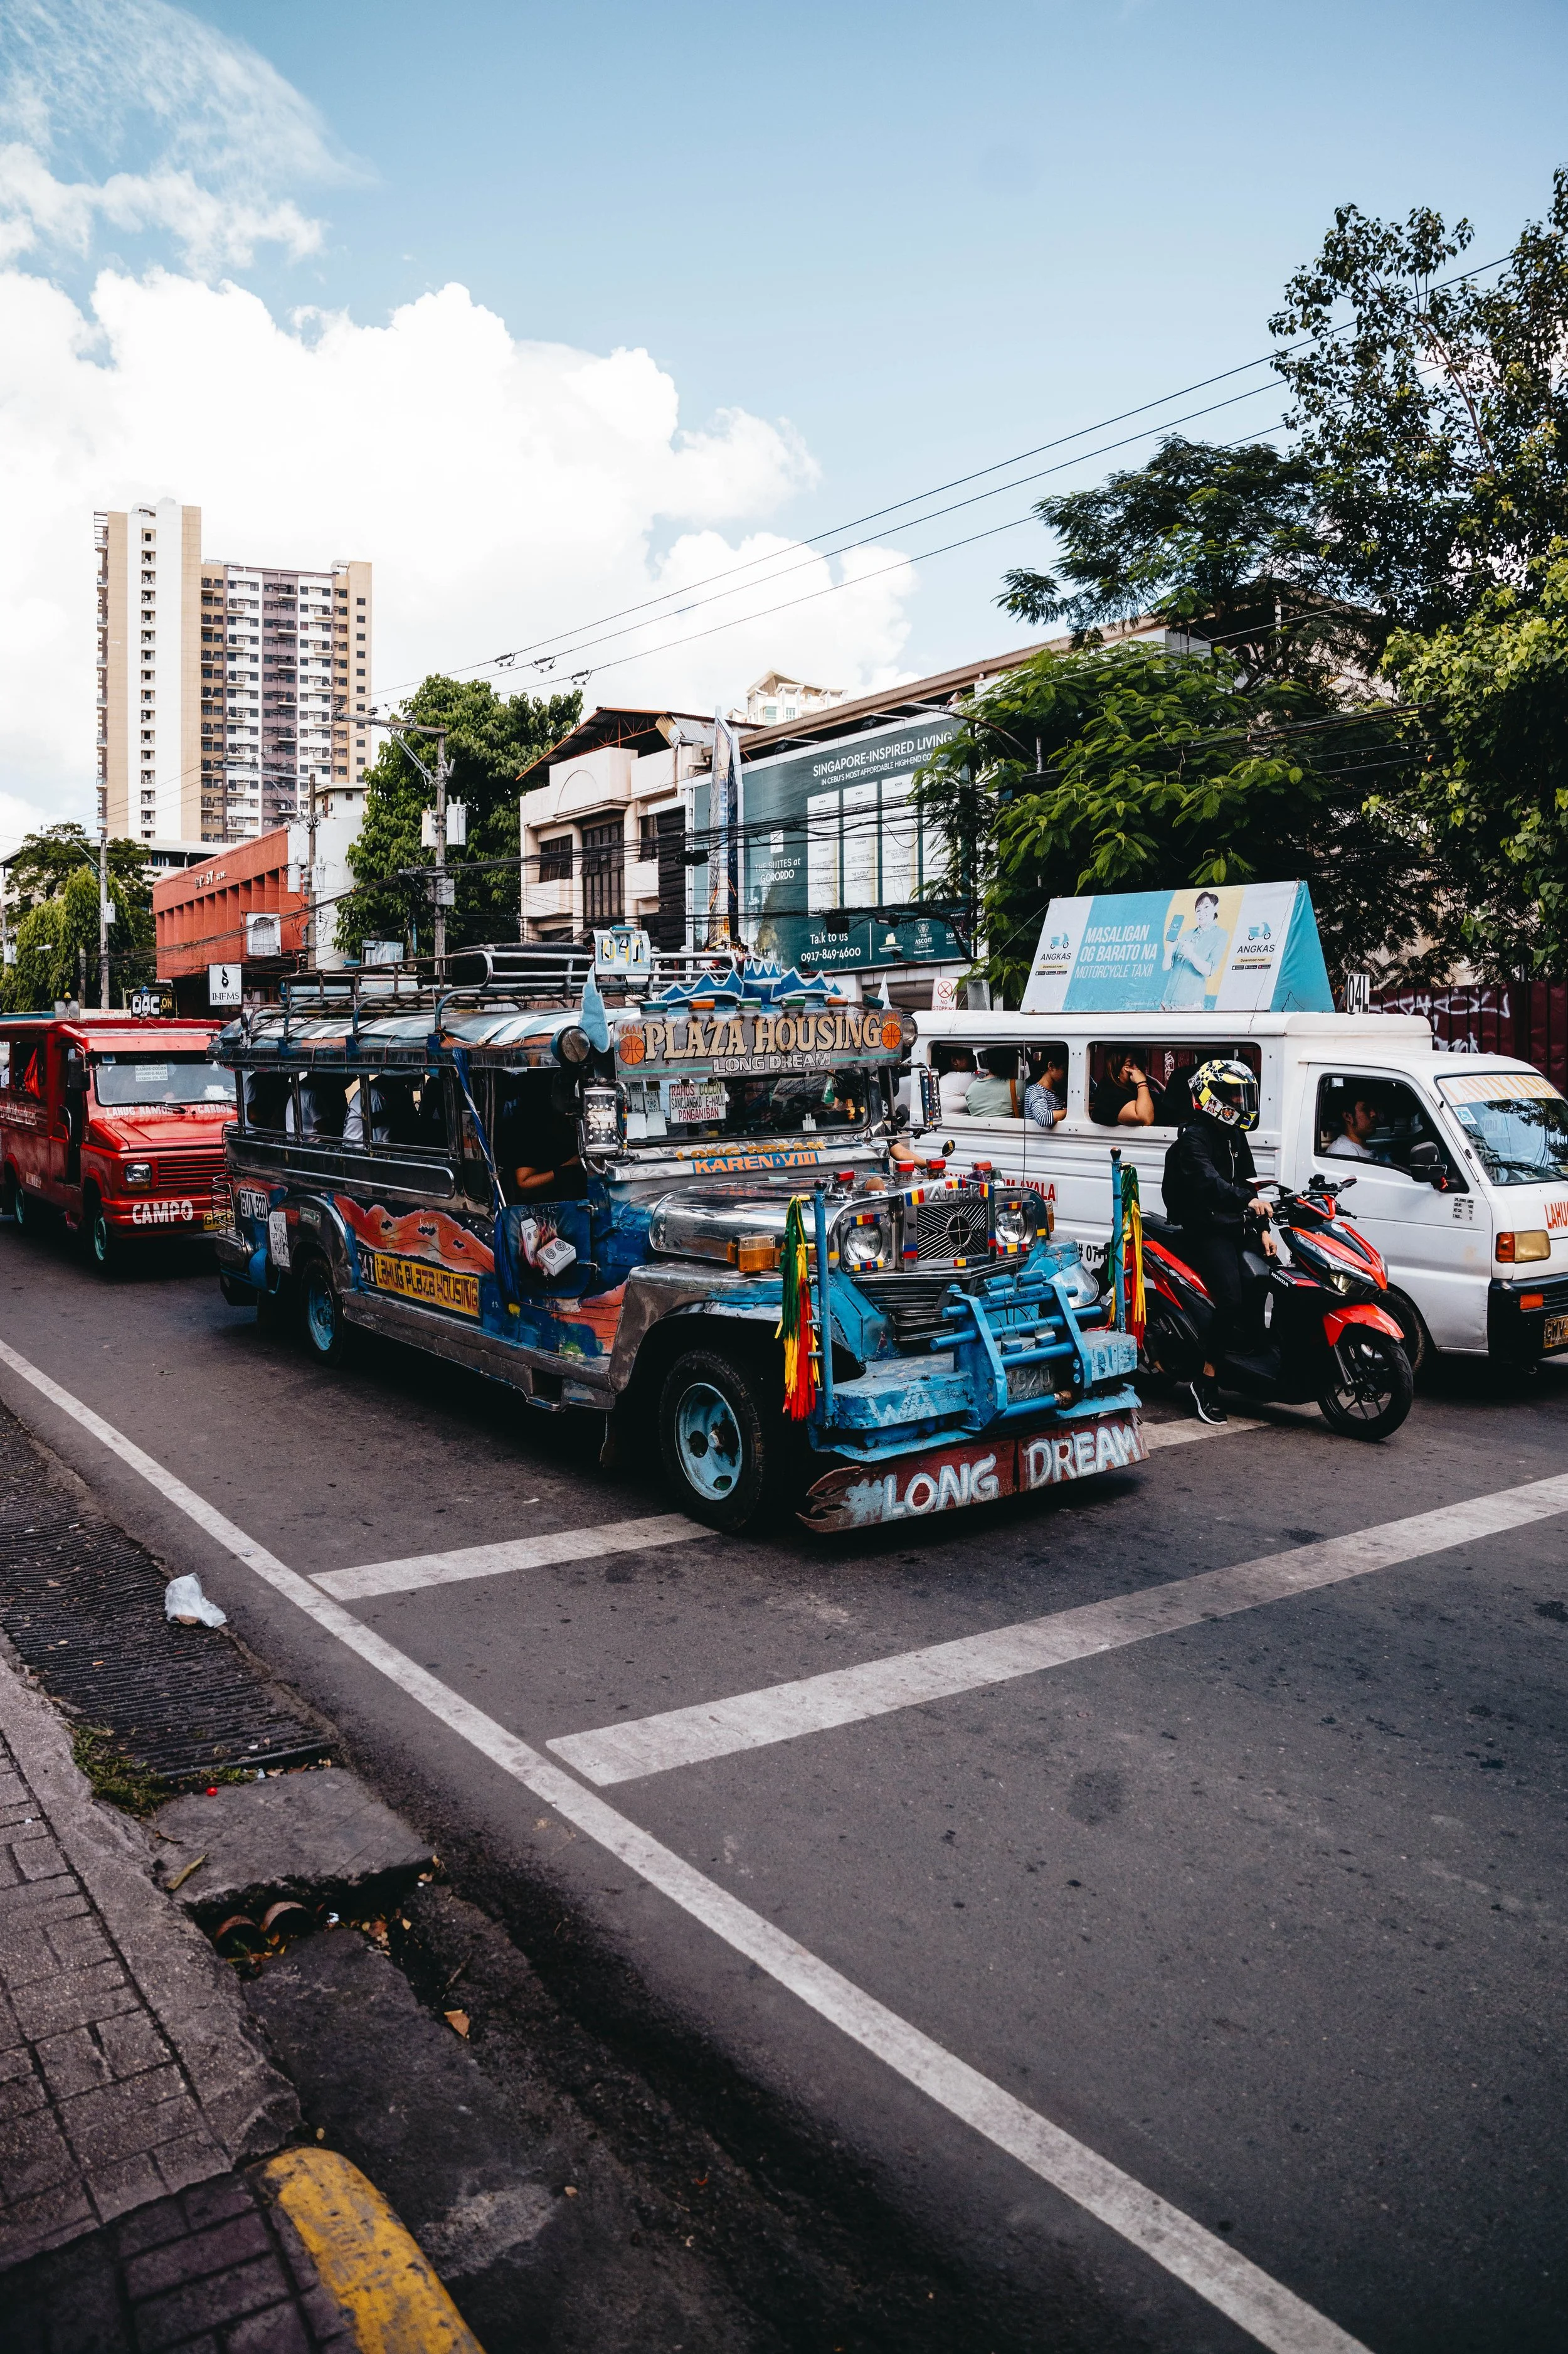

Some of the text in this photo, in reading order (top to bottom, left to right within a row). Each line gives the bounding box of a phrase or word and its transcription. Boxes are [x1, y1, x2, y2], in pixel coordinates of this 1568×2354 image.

[813, 732, 952, 777] SINGAPORE-INSPIRED LIVING
[827, 774, 845, 784] CEBU'S
[845, 771, 860, 780] MOST
[861, 764, 894, 775] AFFORDABLE
[895, 755, 921, 767] HIGH-END
[755, 857, 801, 873] THE SUITES at
[760, 869, 794, 883] GORORDO
[828, 932, 836, 942] to
[839, 932, 848, 941] us
[1084, 924, 1150, 944] MASALIGAN
[601, 937, 642, 963] 041
[801, 947, 861, 962] 0917-849-4600
[1079, 943, 1158, 962] OG BARATO NA
[1237, 944, 1275, 953] ANGKAS
[1074, 964, 1154, 979] MOTORCYCLE TAXI!
[160, 998, 172, 1008] ON
[1348, 975, 1369, 1012] 04L
[132, 995, 160, 1015] 04C
[644, 1013, 882, 1061] PLAZA HOUSING
[712, 1052, 831, 1073] LONG DREAM
[671, 1083, 722, 1097] RAMOS COLON
[106, 1104, 233, 1117] LAHUG RAMOS CARBON
[671, 1095, 725, 1110] SANCIANGKO E-MALL
[679, 1107, 719, 1121] PANGANIBAN
[694, 1152, 817, 1174] KAREN VIII
[132, 1200, 194, 1224] CAMPO
[1271, 1272, 1289, 1287] HONDA
[436, 1274, 479, 1312] HOUSING
[1022, 1426, 1141, 1491] DREAM
